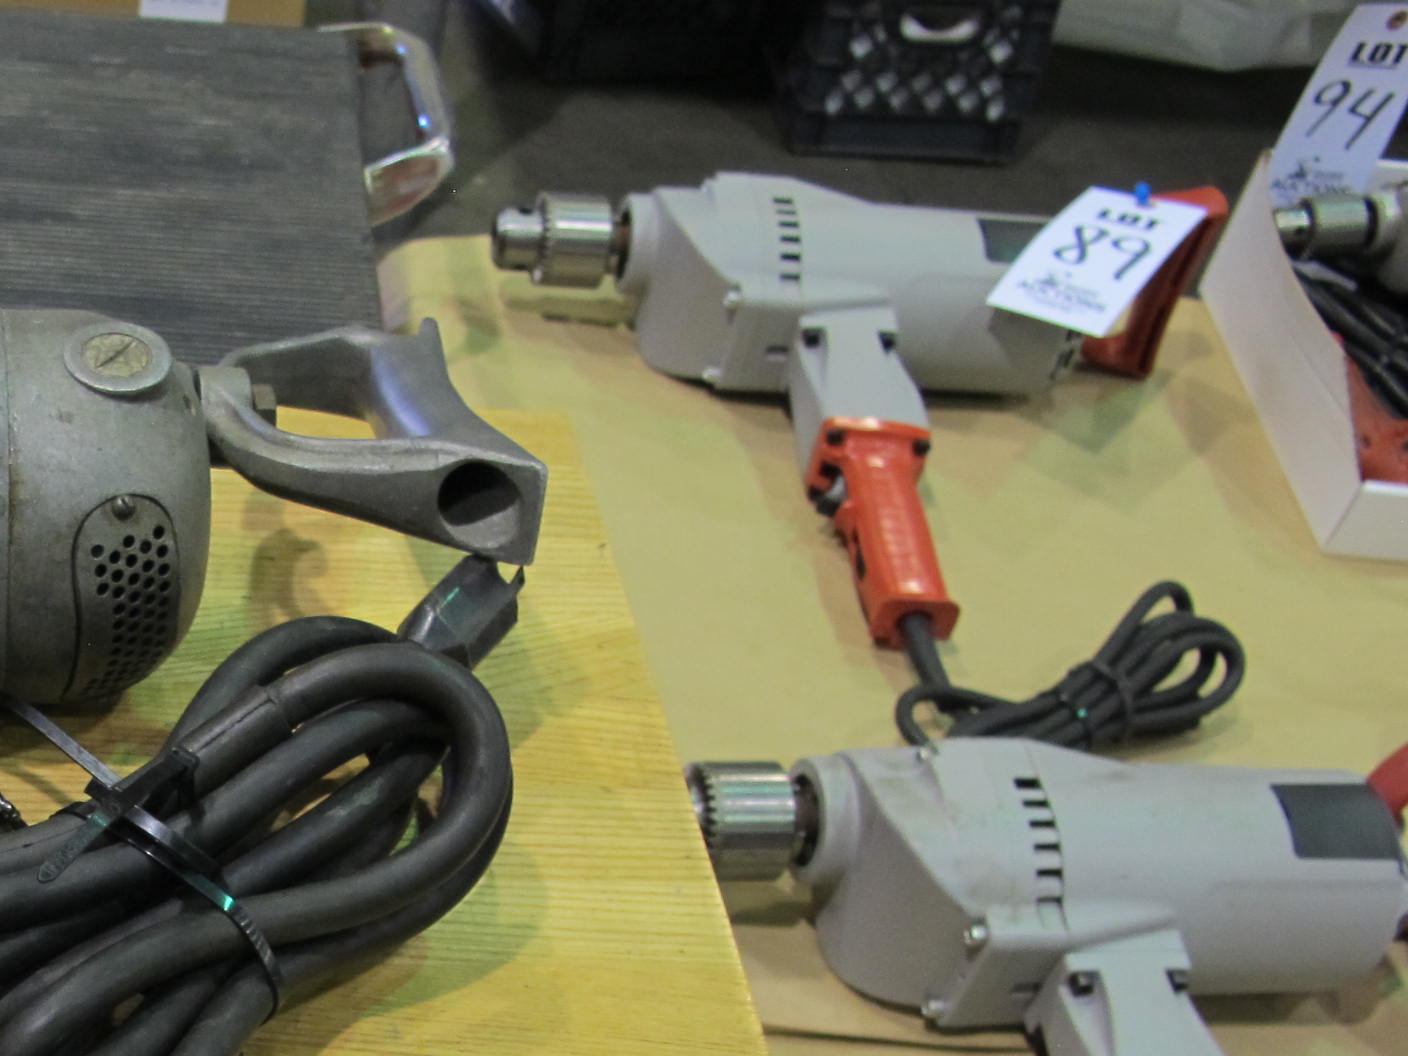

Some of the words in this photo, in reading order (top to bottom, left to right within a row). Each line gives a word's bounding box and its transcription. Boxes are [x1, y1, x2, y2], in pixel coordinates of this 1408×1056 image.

[1351, 41, 1408, 65] LOT
[1305, 80, 1396, 151] 94
[1097, 208, 1161, 230] LOT
[1053, 225, 1153, 281] 89
